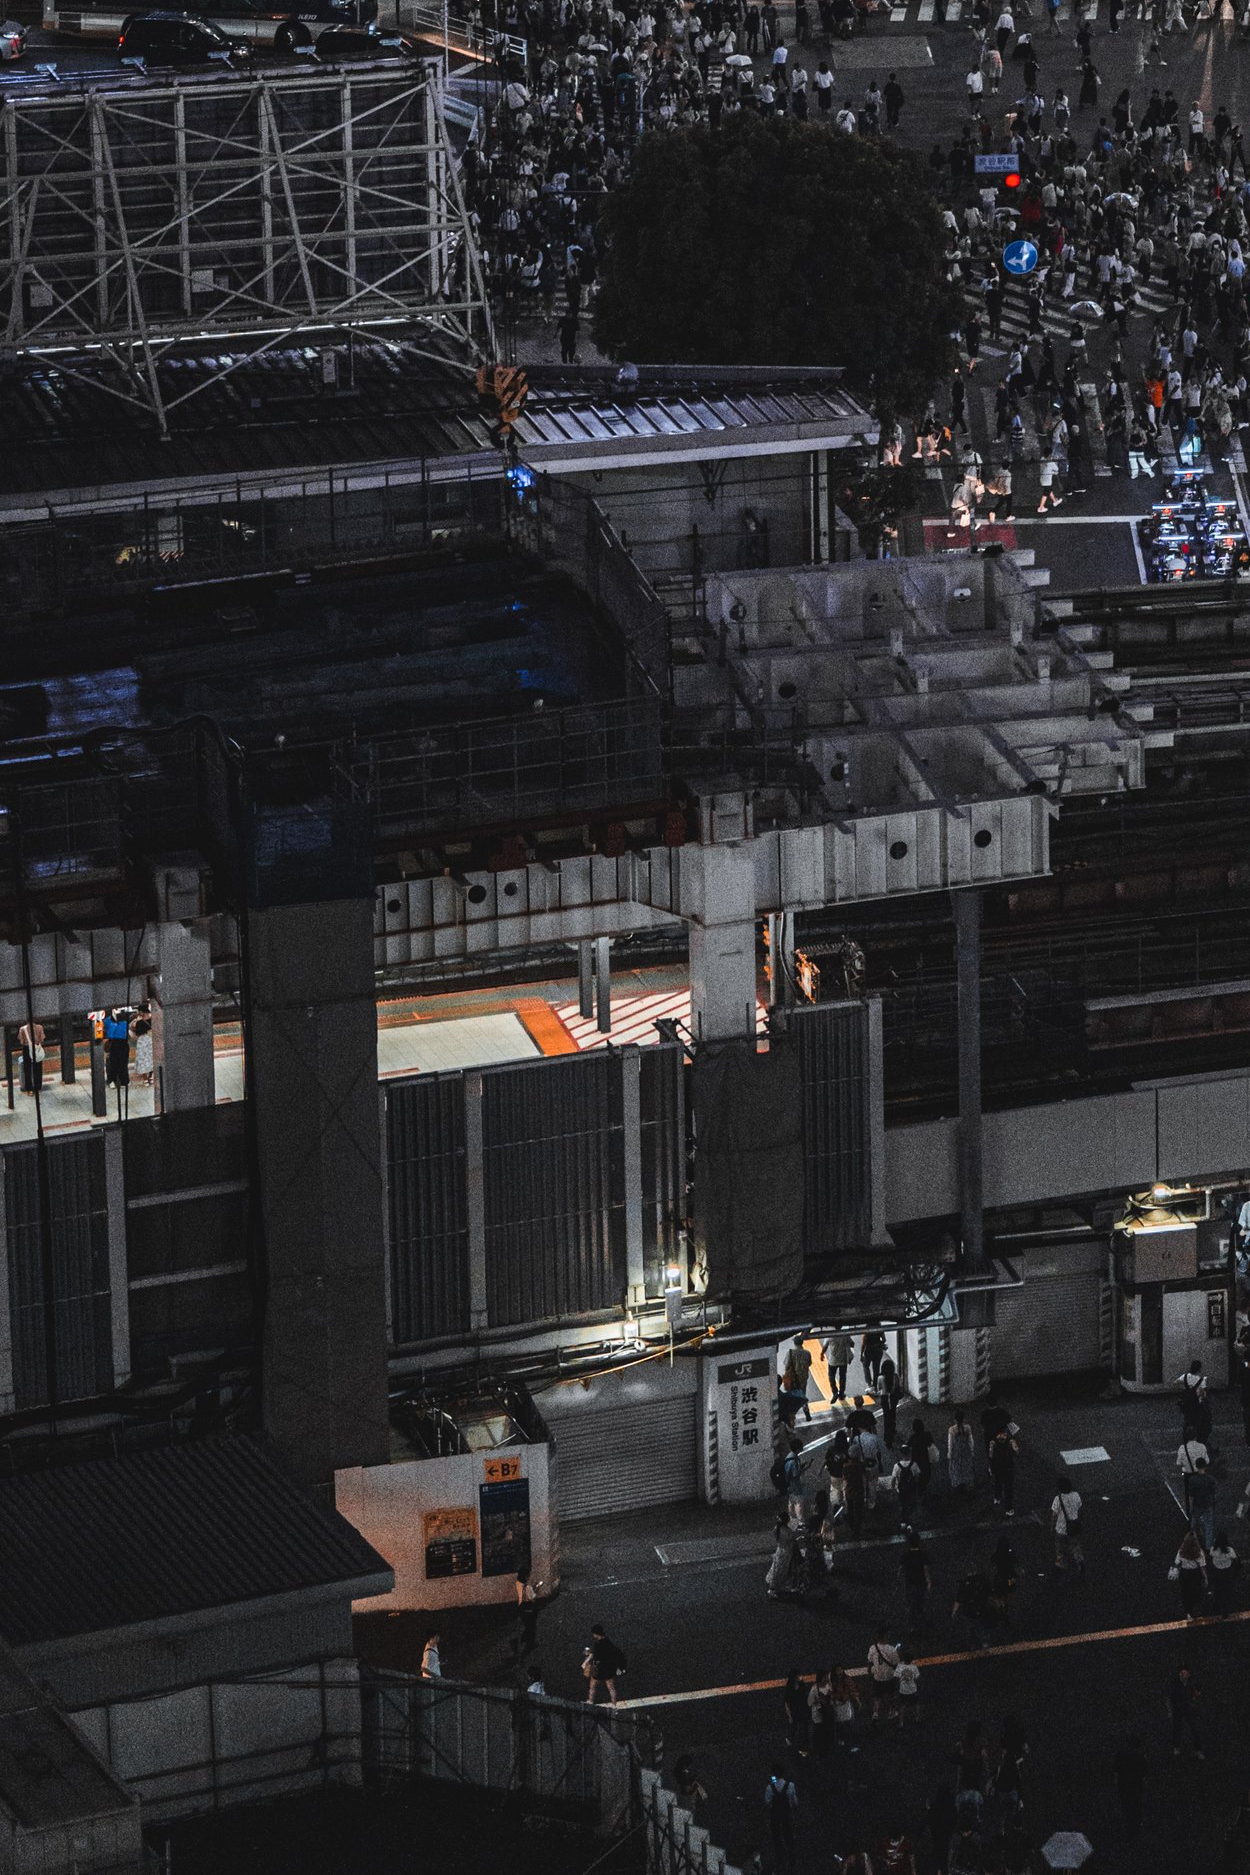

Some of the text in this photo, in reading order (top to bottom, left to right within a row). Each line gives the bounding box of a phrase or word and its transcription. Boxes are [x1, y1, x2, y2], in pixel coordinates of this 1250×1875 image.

[729, 1386, 739, 1452] Shibuya Station
[741, 1386, 759, 1446] 渋谷駅
[501, 1463, 518, 1476] B7
